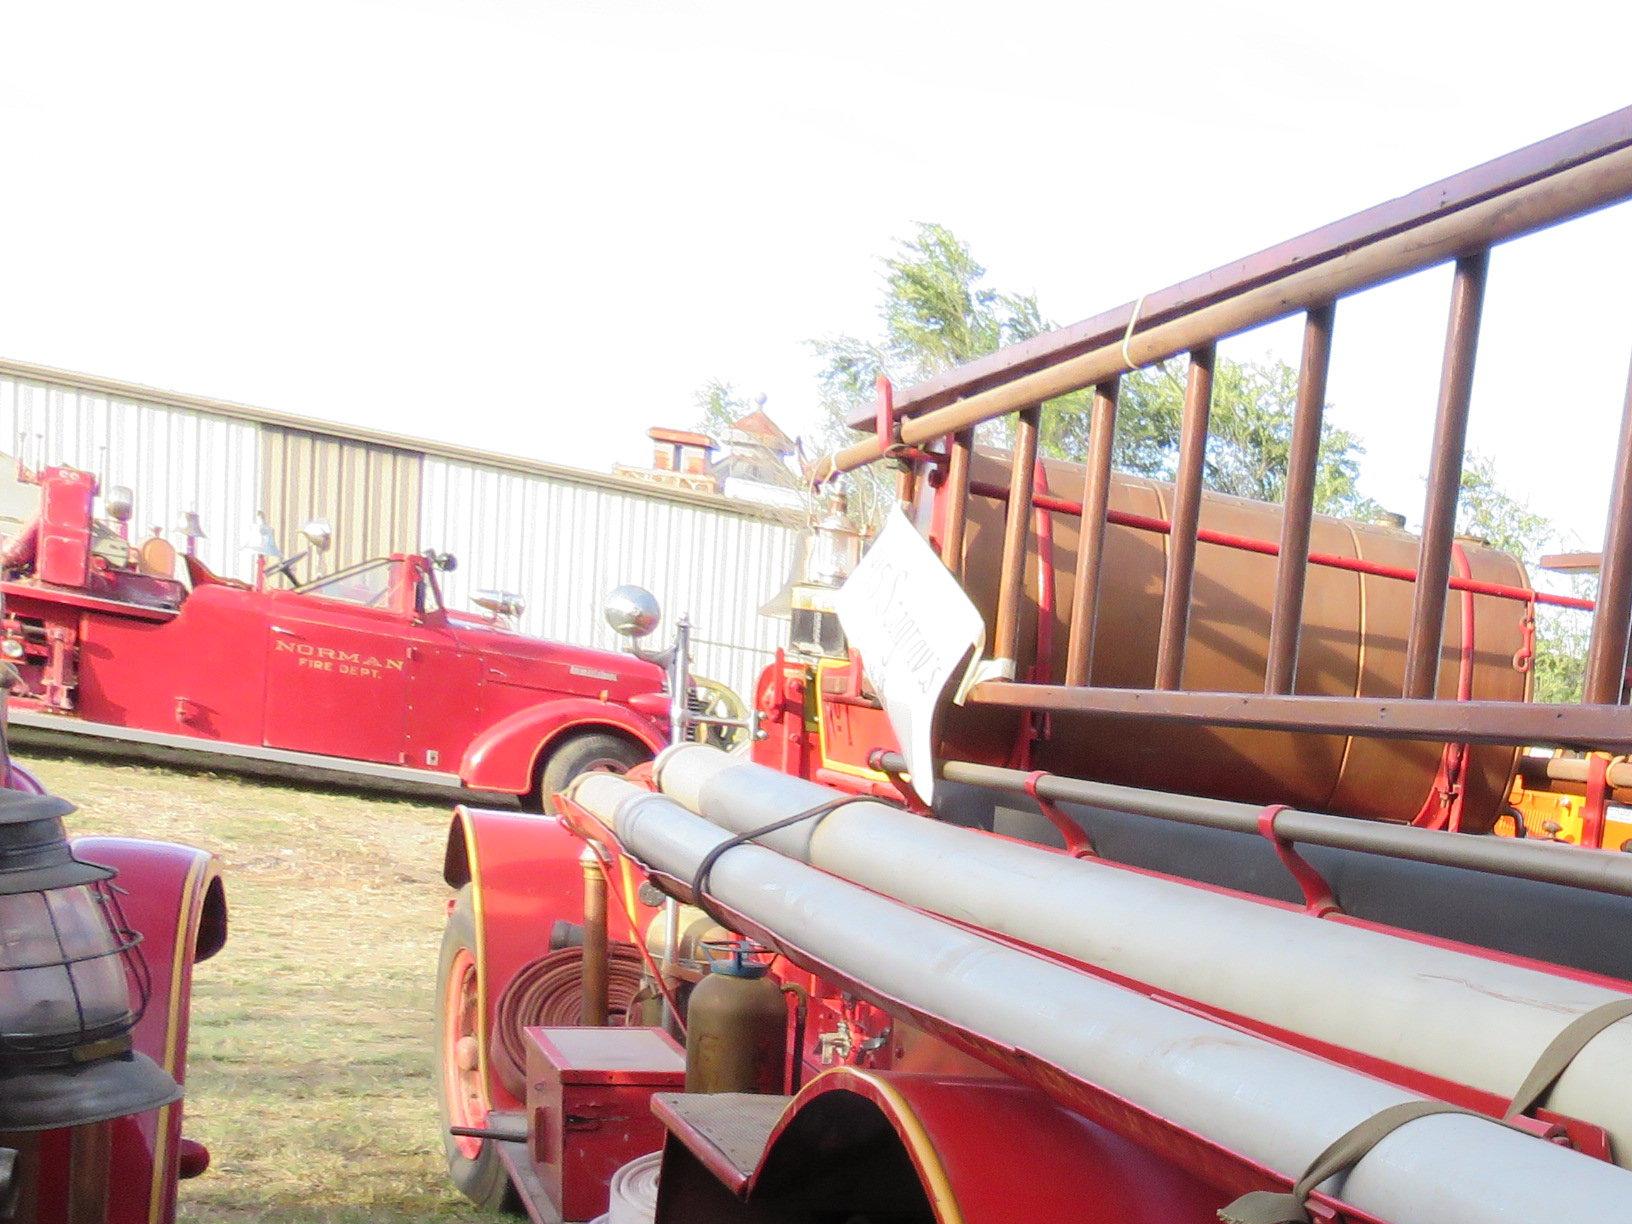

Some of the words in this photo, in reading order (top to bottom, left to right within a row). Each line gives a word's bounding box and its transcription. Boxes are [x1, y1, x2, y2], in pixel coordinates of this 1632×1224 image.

[274, 640, 404, 672] NORMAN
[298, 657, 333, 672] FIRE
[339, 664, 382, 679] DEPT.
